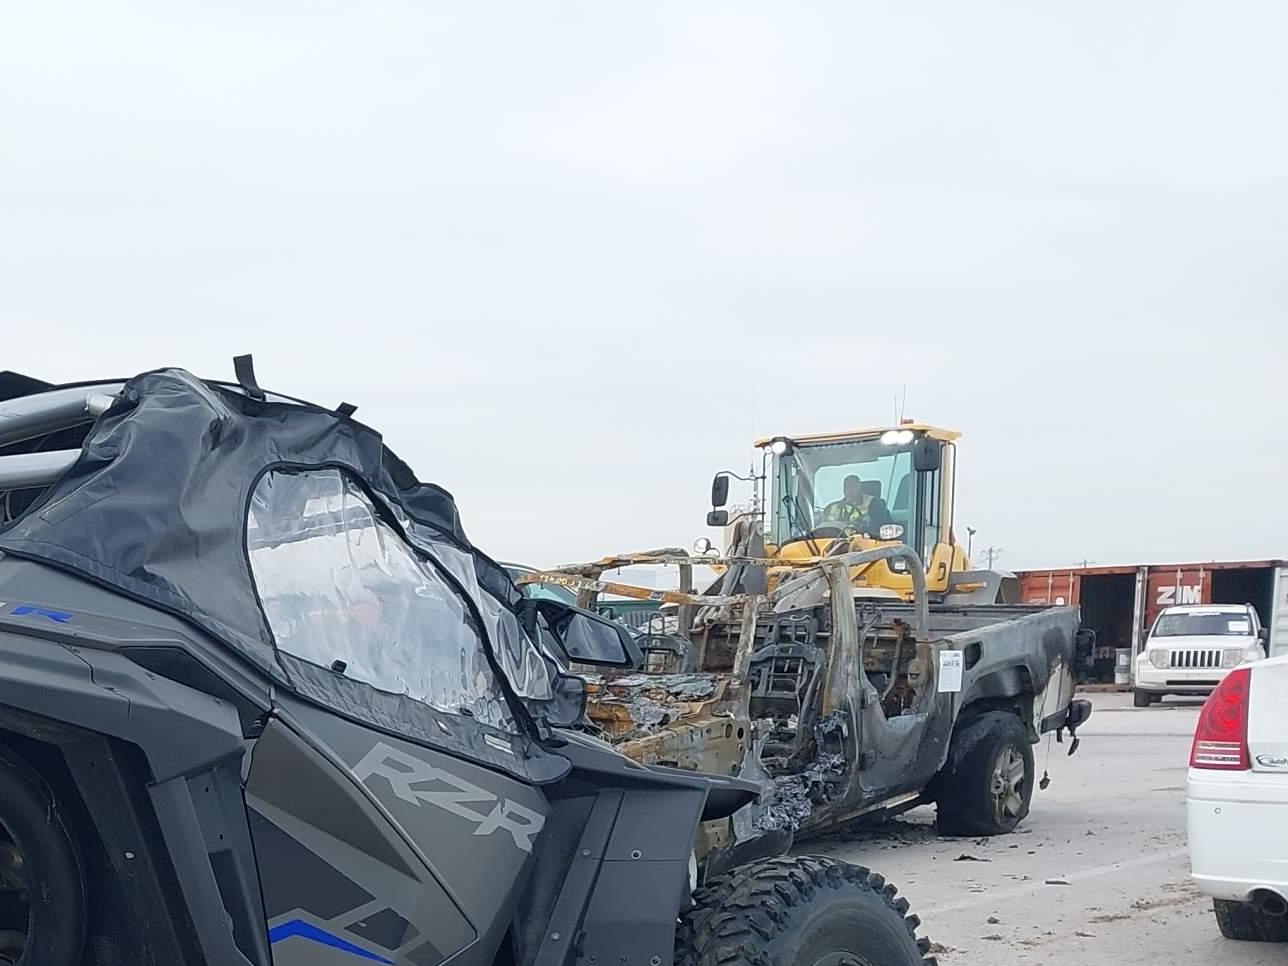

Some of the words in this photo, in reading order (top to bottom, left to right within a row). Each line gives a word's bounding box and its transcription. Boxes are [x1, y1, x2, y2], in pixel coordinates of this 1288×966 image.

[1156, 585, 1202, 605] ZIM
[10, 606, 74, 624] R
[351, 741, 546, 853] RZR
